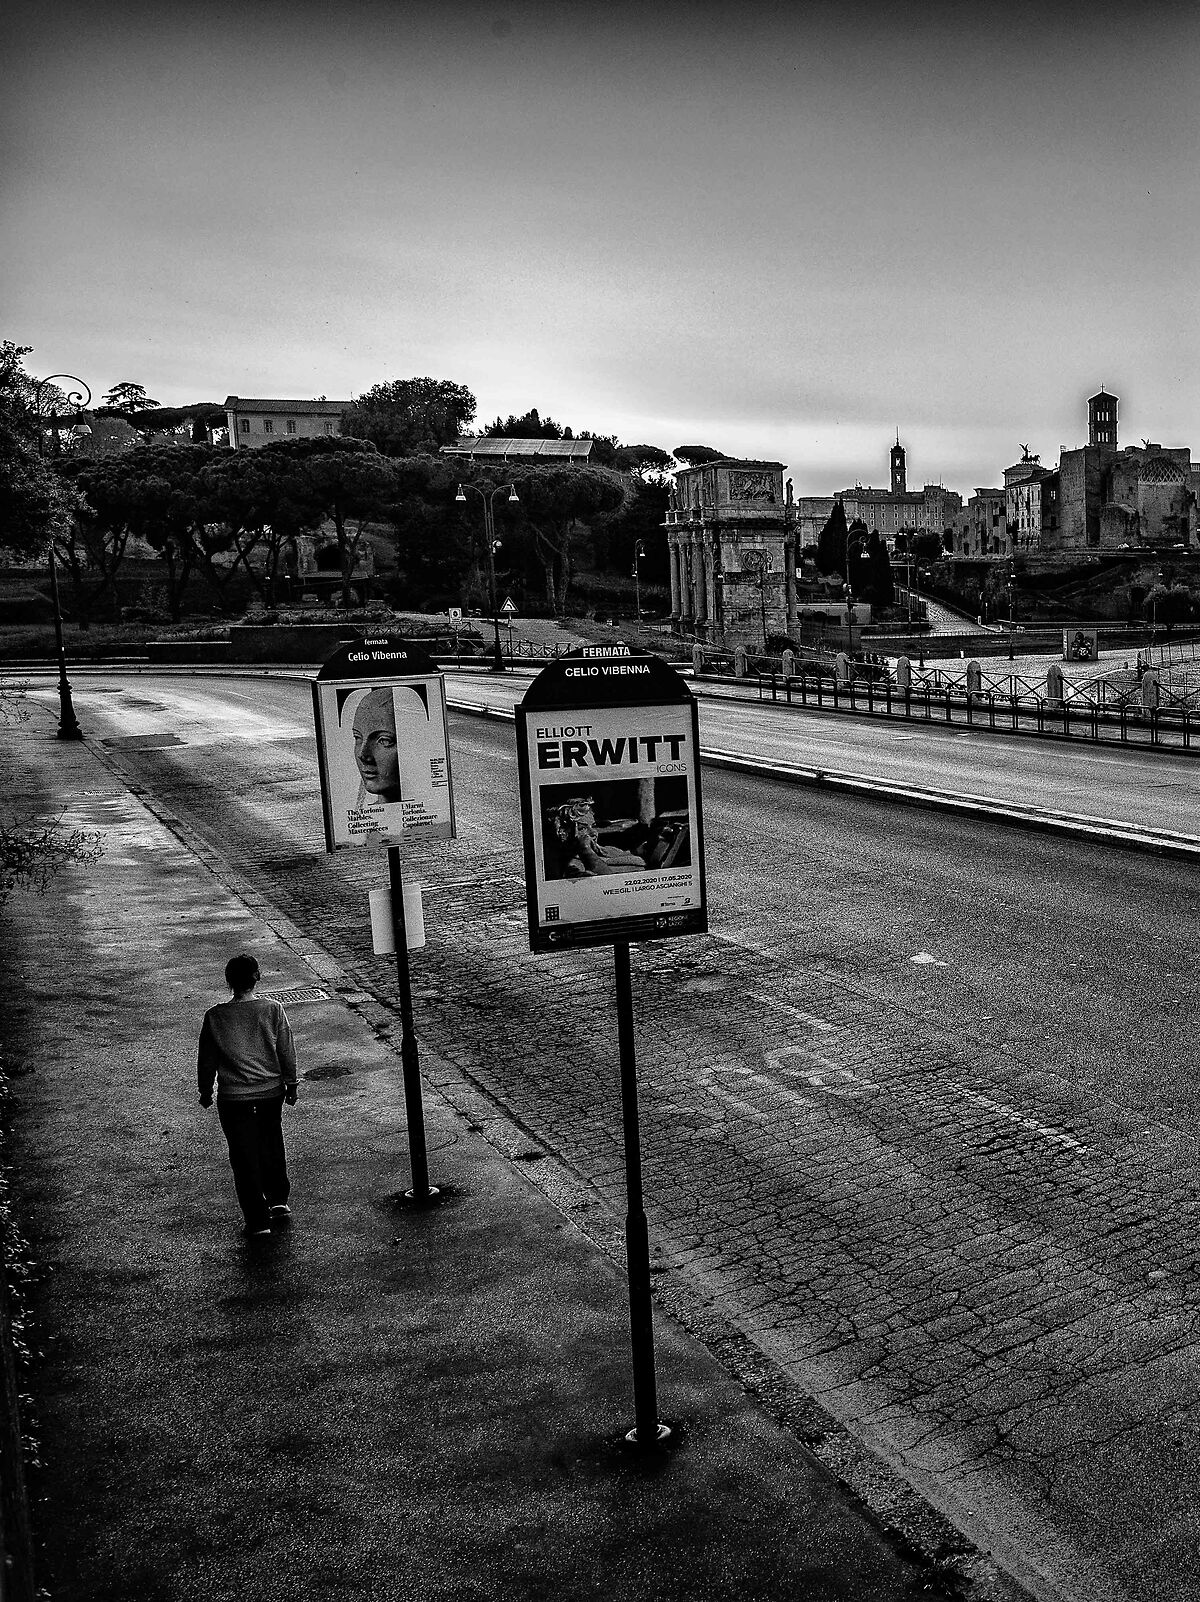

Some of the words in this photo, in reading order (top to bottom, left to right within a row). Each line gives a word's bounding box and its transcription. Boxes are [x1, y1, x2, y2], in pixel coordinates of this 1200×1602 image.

[348, 652, 370, 661] Celio
[371, 651, 408, 660] Vibenna
[582, 646, 631, 658] FERMATA
[565, 666, 599, 677] CELIO
[601, 664, 651, 676] VIBENNA
[536, 725, 593, 739] ELLIOTT
[537, 734, 686, 770] ERWITT
[656, 763, 687, 773] ICONS
[360, 807, 385, 815] Torlonia
[347, 820, 379, 829] Collecting
[348, 826, 389, 835] Masterpieces
